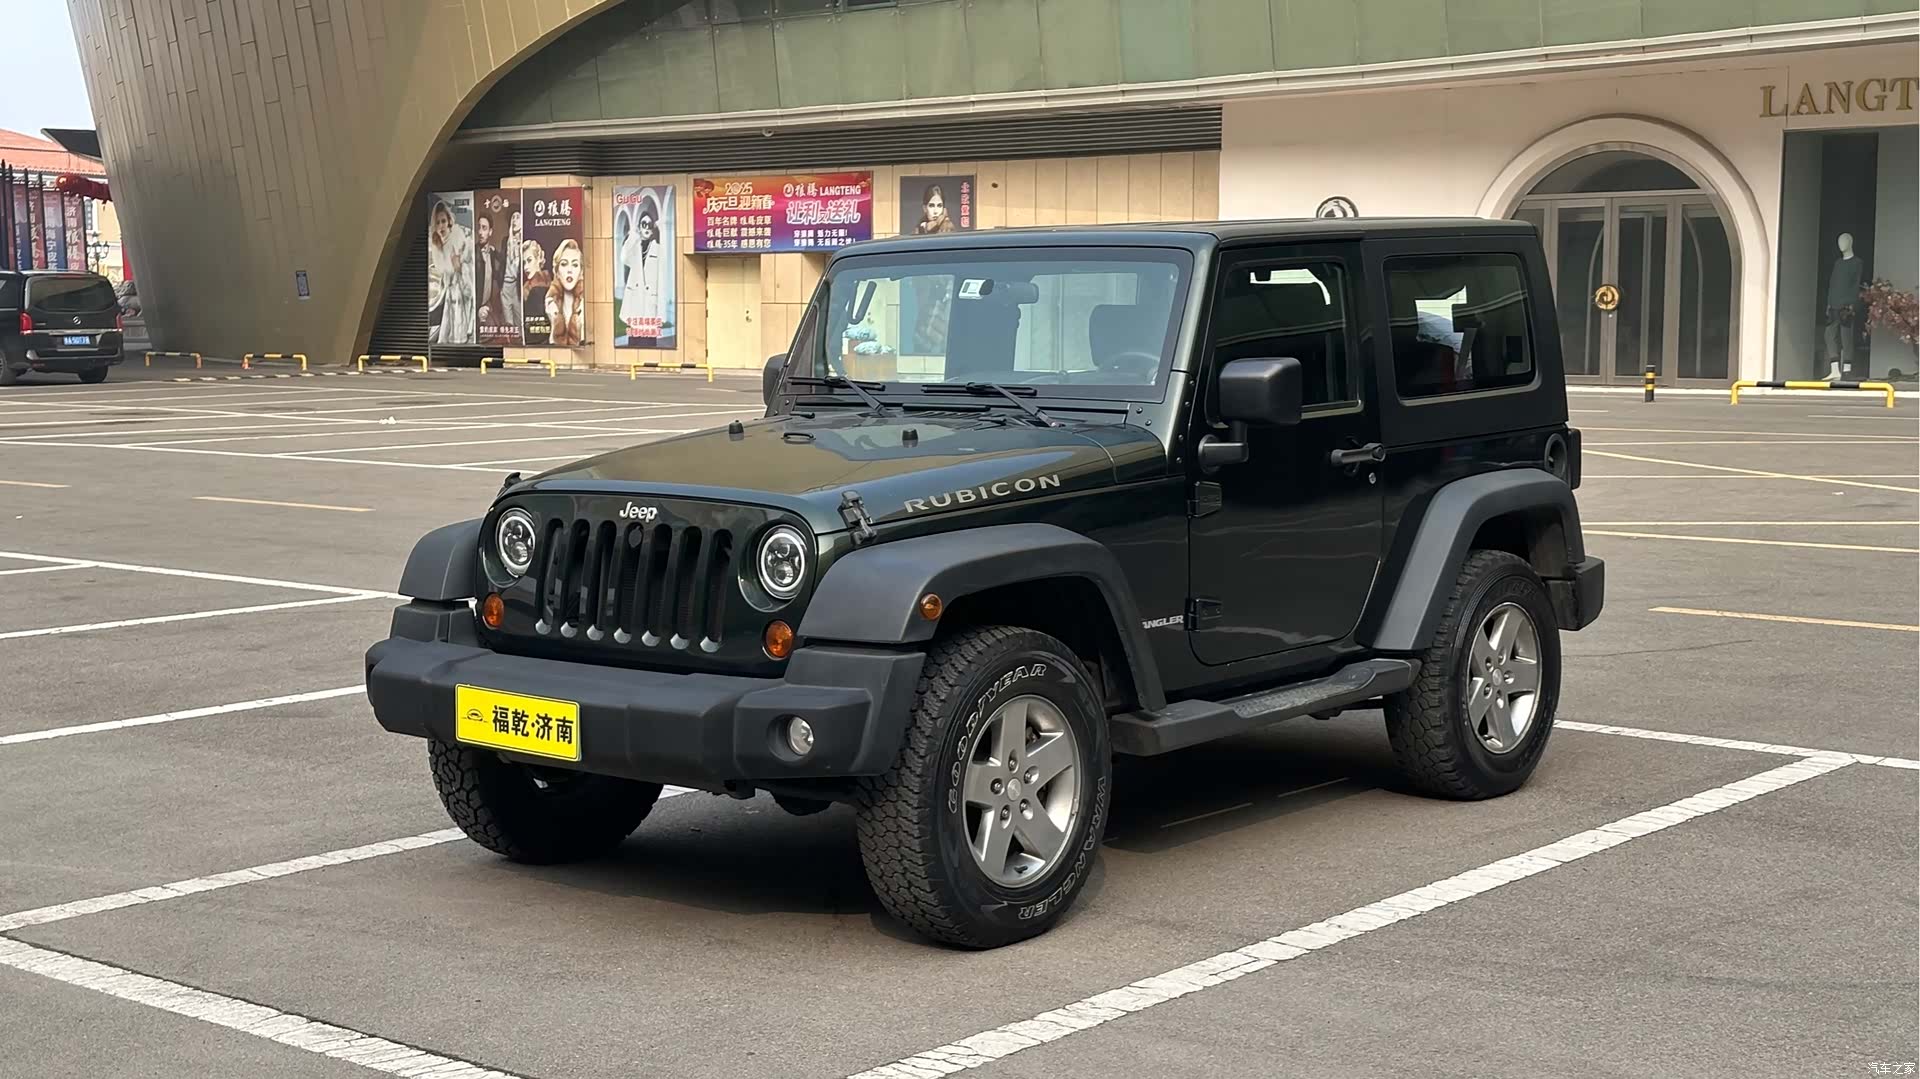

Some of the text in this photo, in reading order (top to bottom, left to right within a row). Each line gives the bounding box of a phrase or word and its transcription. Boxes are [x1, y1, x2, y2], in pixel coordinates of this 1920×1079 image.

[1759, 77, 1919, 118] LANGT
[725, 182, 753, 195] 2025
[820, 185, 862, 196] LANGTENG
[703, 194, 775, 214] 庆元旦迎新春
[535, 218, 571, 227] LANGTENG
[707, 216, 738, 226] 百年名牌
[903, 474, 1061, 513] RUBICON
[619, 501, 657, 523] Jeep
